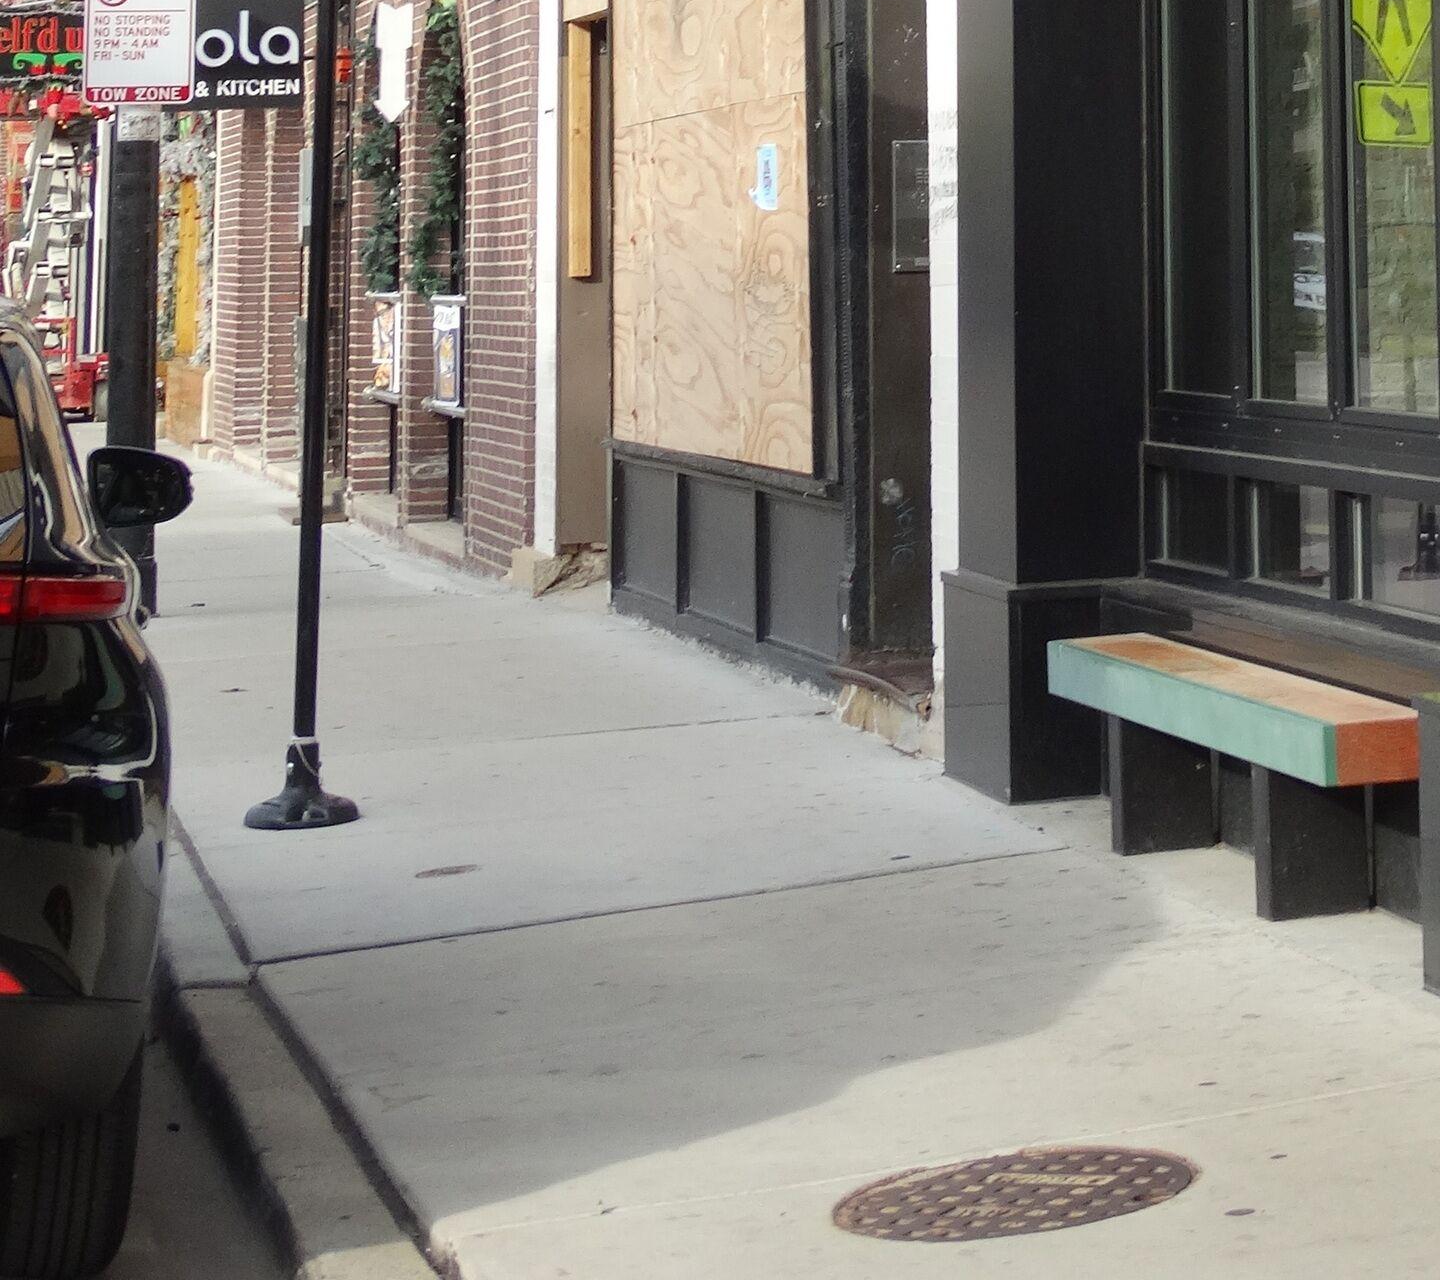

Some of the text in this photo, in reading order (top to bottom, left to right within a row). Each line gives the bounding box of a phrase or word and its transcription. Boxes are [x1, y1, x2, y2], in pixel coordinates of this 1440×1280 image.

[94, 15, 171, 25] NO STOPPING
[94, 26, 171, 37] NO STANDING
[142, 39, 159, 48] AM
[94, 51, 111, 61] FRI
[121, 50, 145, 60] SUN
[195, 78, 300, 98] & KITCHEN
[91, 87, 182, 101] TOW ZONE
